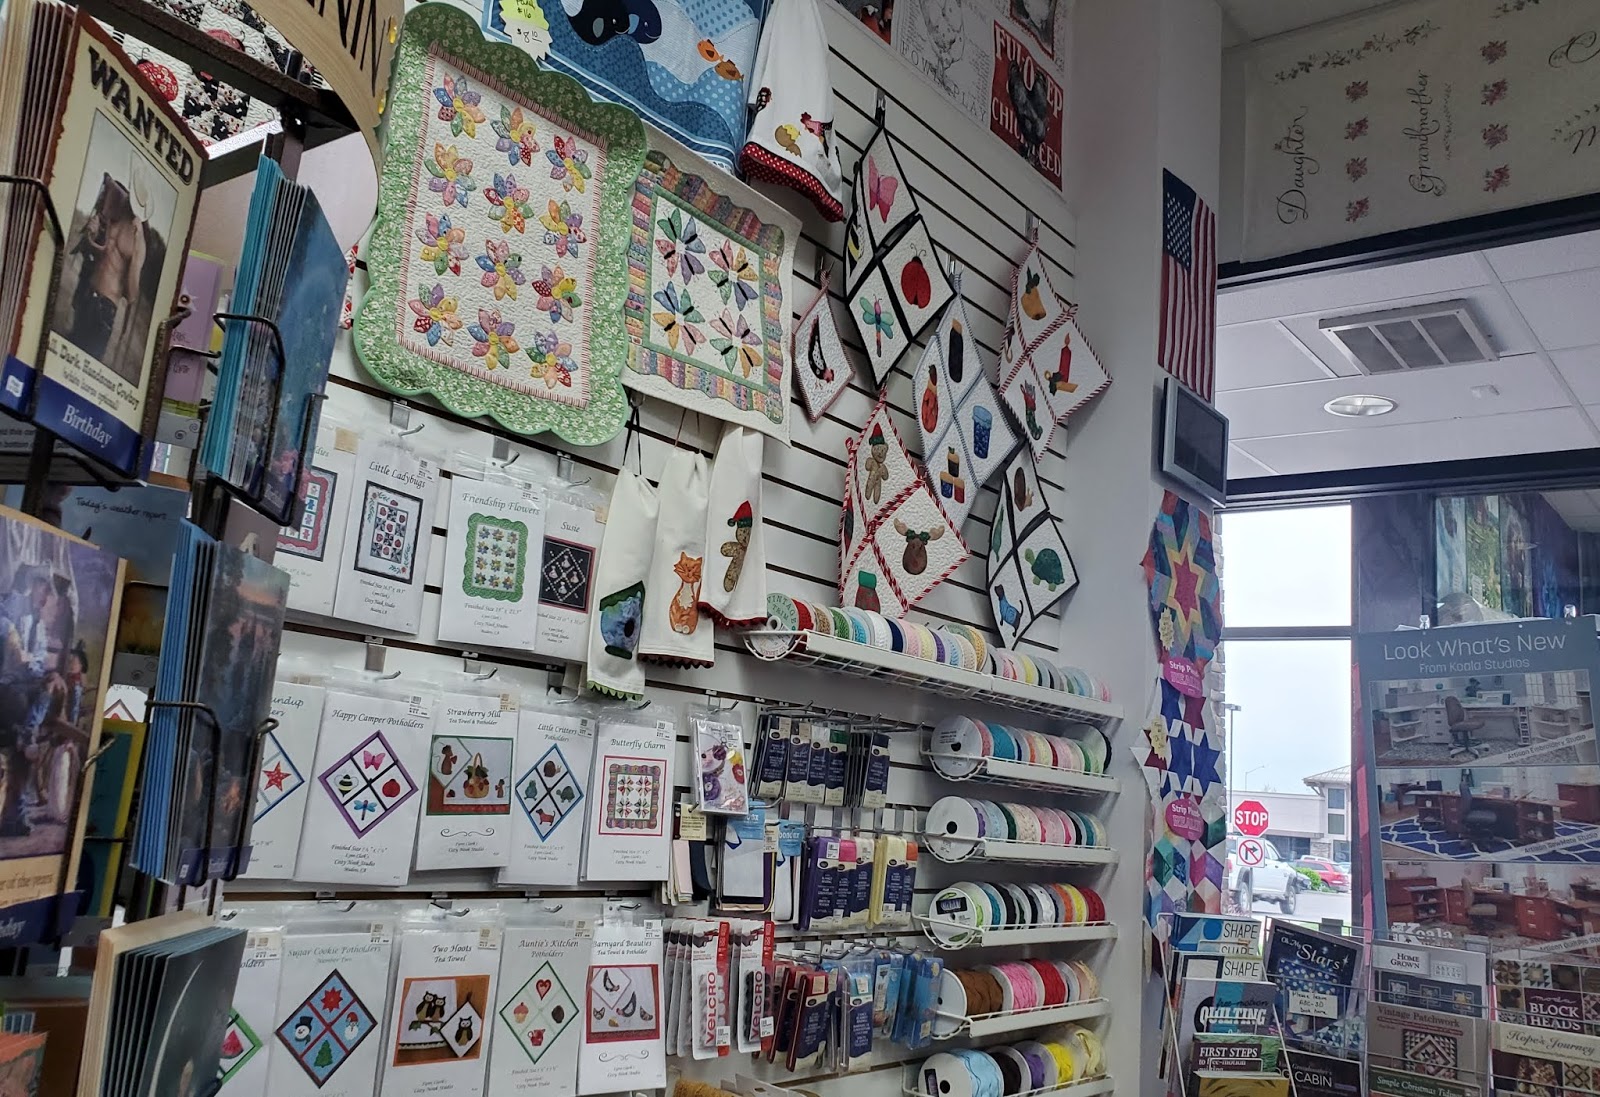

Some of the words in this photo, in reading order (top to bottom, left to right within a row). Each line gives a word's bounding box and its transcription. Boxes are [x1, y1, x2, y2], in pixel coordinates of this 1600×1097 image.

[87, 45, 194, 186] WANTED
[1402, 69, 1446, 197] Grandmother
[1276, 106, 1320, 224] Daughter
[62, 404, 113, 448] Birthday
[369, 461, 391, 476] Little
[391, 469, 426, 489] Ladybugs
[76, 497, 107, 514] Today's
[462, 492, 506, 509] Friendship
[507, 501, 540, 516] Flowers
[560, 521, 581, 533] Susie
[1383, 641, 1432, 661] Look
[1436, 635, 1511, 657] What's
[1516, 633, 1567, 651] New
[1169, 661, 1185, 673] Strip
[1419, 662, 1447, 673] From
[1449, 660, 1482, 672] Koala
[1484, 657, 1530, 670] Studios
[272, 696, 304, 708] undup
[331, 709, 358, 724] Happy
[358, 713, 387, 725] Camper
[387, 716, 425, 730] Potholders
[446, 708, 486, 721] Strawberry
[487, 709, 502, 718] Hill
[537, 723, 554, 732] Little
[554, 725, 578, 735] Critters
[611, 738, 642, 750] Butterfly
[643, 740, 666, 750] Charm
[1507, 750, 1530, 759] Artisan
[1171, 803, 1187, 815] Strip
[1235, 810, 1268, 827] STOP
[1223, 922, 1259, 939] SHAPE
[1391, 921, 1453, 946] Koala
[288, 949, 311, 959] Sugar
[313, 947, 339, 956] Cookie
[341, 944, 382, 955] Potholders
[432, 944, 448, 954] Two
[449, 944, 472, 953] Hoots
[518, 939, 549, 949] Auntie's
[549, 939, 579, 947] Kitchen
[593, 940, 624, 949] Barnyard
[625, 940, 652, 948] Beauties
[448, 955, 467, 963] Towel
[1296, 943, 1341, 970] Stars
[1390, 958, 1420, 969] GROWN
[1397, 952, 1420, 963] HOME
[1223, 960, 1260, 977] SHAPE
[1199, 1006, 1267, 1026] QUILTING
[1377, 1006, 1411, 1019] Vintage
[1413, 1012, 1460, 1028] Patchwork
[1528, 1002, 1580, 1018] BLOCK
[1530, 1015, 1581, 1031] HEADS
[1506, 1030, 1545, 1046] Hope's
[1546, 1036, 1595, 1056] Journey
[1200, 1046, 1227, 1057] FIRST
[1229, 1047, 1258, 1058] STEPS
[1294, 1071, 1333, 1088] CABIN
[1376, 1076, 1400, 1088] Simple
[1401, 1081, 1437, 1095] Christmas
